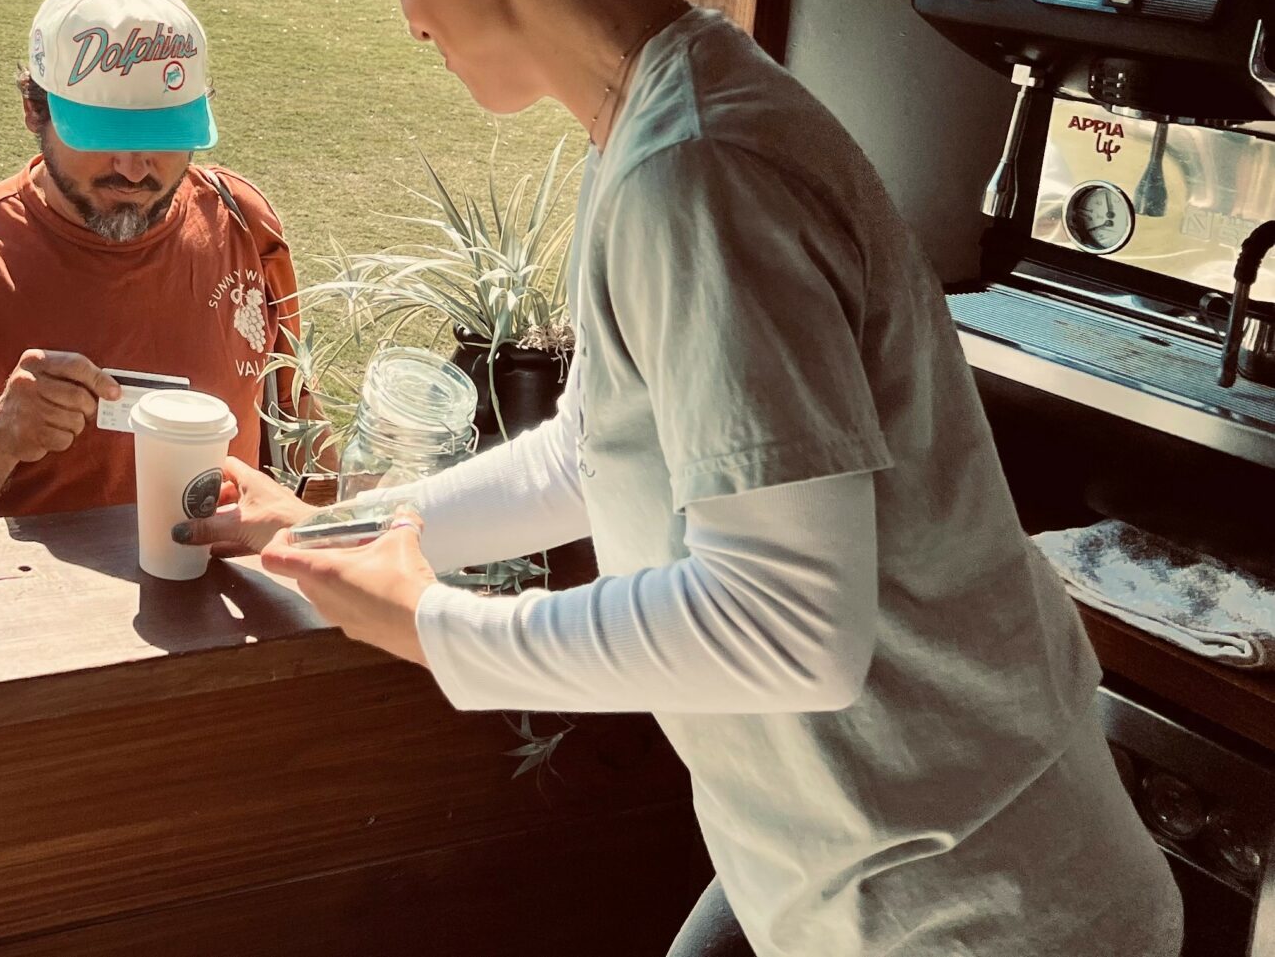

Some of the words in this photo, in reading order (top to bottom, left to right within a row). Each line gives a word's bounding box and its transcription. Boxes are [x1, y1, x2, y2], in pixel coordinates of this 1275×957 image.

[67, 23, 197, 87] Dolphins
[1068, 116, 1125, 139] APPIA
[209, 268, 241, 309] SUNNY
